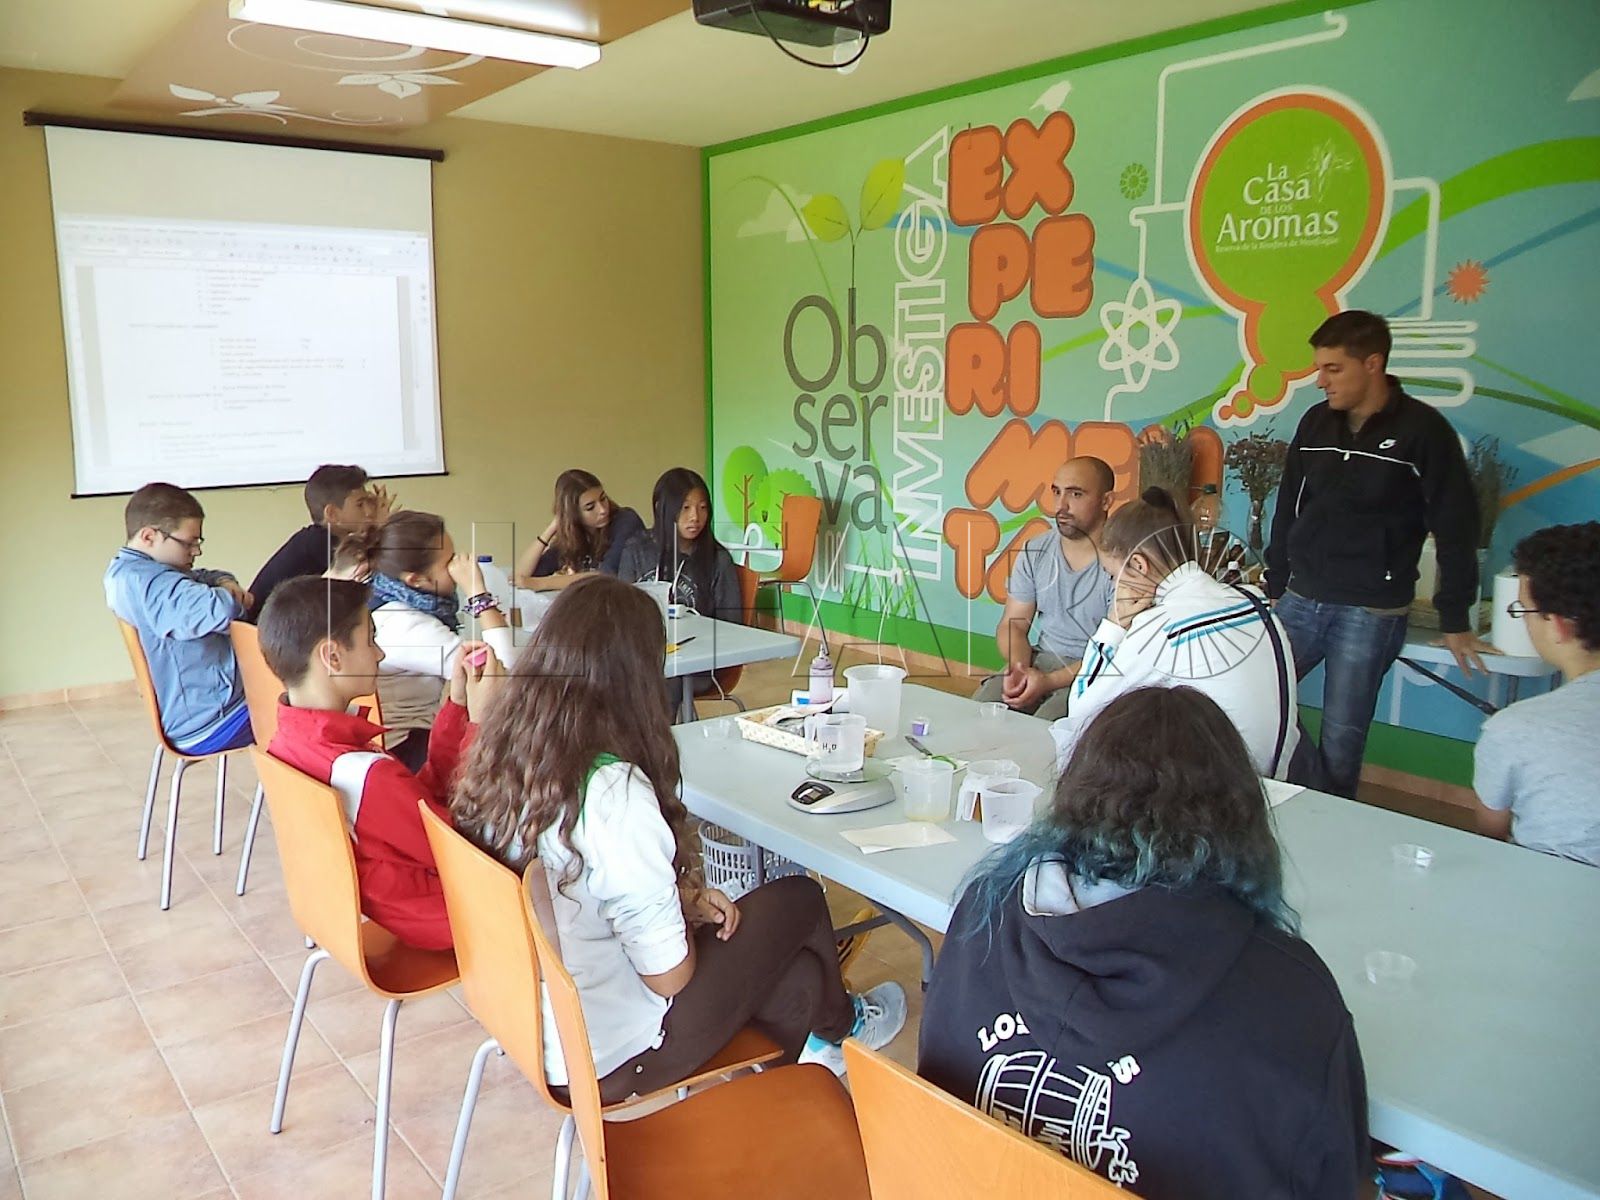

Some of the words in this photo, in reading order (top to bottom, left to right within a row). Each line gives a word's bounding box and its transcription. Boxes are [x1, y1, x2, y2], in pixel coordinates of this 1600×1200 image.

[948, 110, 1075, 226] EX
[1243, 176, 1312, 205] Casa
[1267, 162, 1287, 181] La
[968, 213, 1096, 322] PE
[1216, 210, 1339, 243] Aromas
[783, 287, 887, 394] Ob
[893, 125, 950, 582] INVESTIGA
[944, 320, 1042, 418] RI
[791, 391, 888, 463] ser
[814, 459, 888, 534] va
